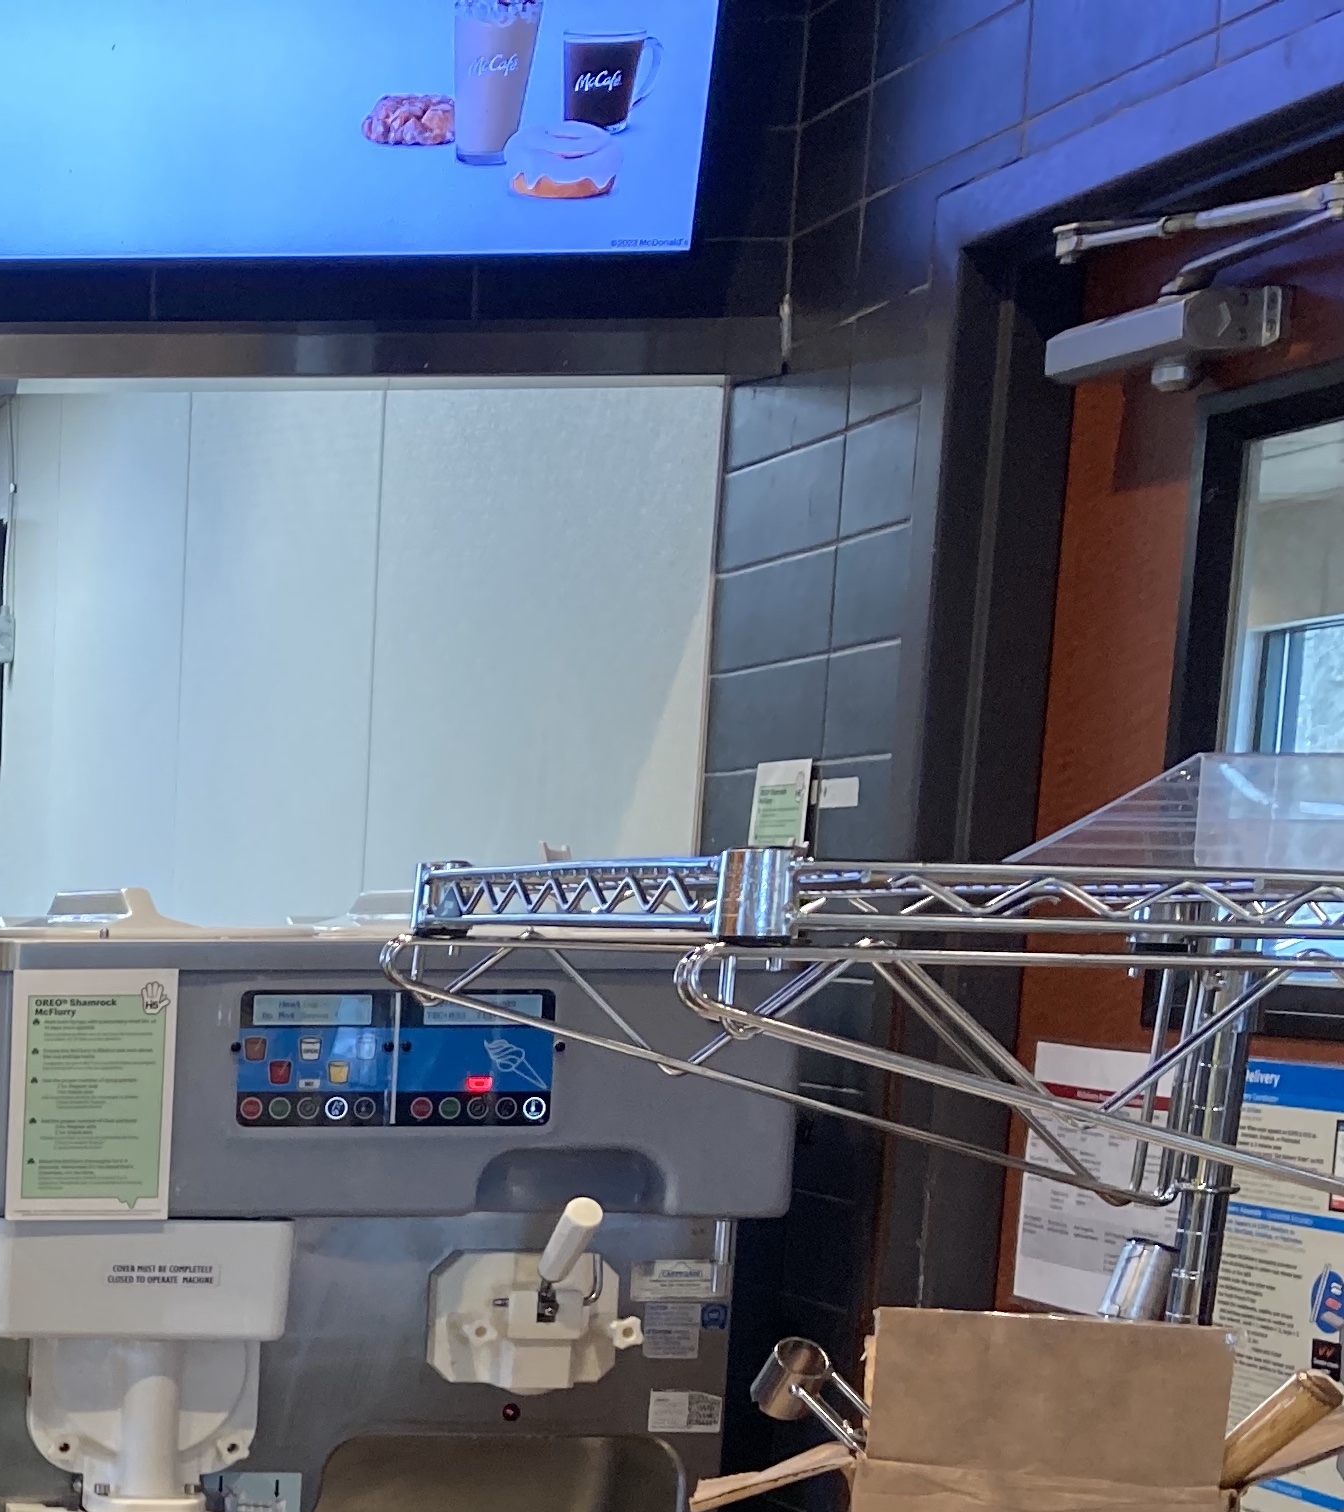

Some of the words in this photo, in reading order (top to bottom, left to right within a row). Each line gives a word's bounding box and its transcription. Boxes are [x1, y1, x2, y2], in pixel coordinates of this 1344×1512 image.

[575, 70, 622, 92] McCafé
[69, 998, 117, 1007] Shamrock
[34, 1007, 76, 1018] McFlurry
[112, 1265, 135, 1273] COVER
[137, 1265, 156, 1273] MUST
[158, 1265, 167, 1273] BE
[169, 1265, 213, 1274] COMPLETELY
[107, 1275, 134, 1284] CLOSED
[136, 1275, 145, 1284] TO
[147, 1275, 178, 1284] OPERATE
[182, 1276, 213, 1284] MACHINE
